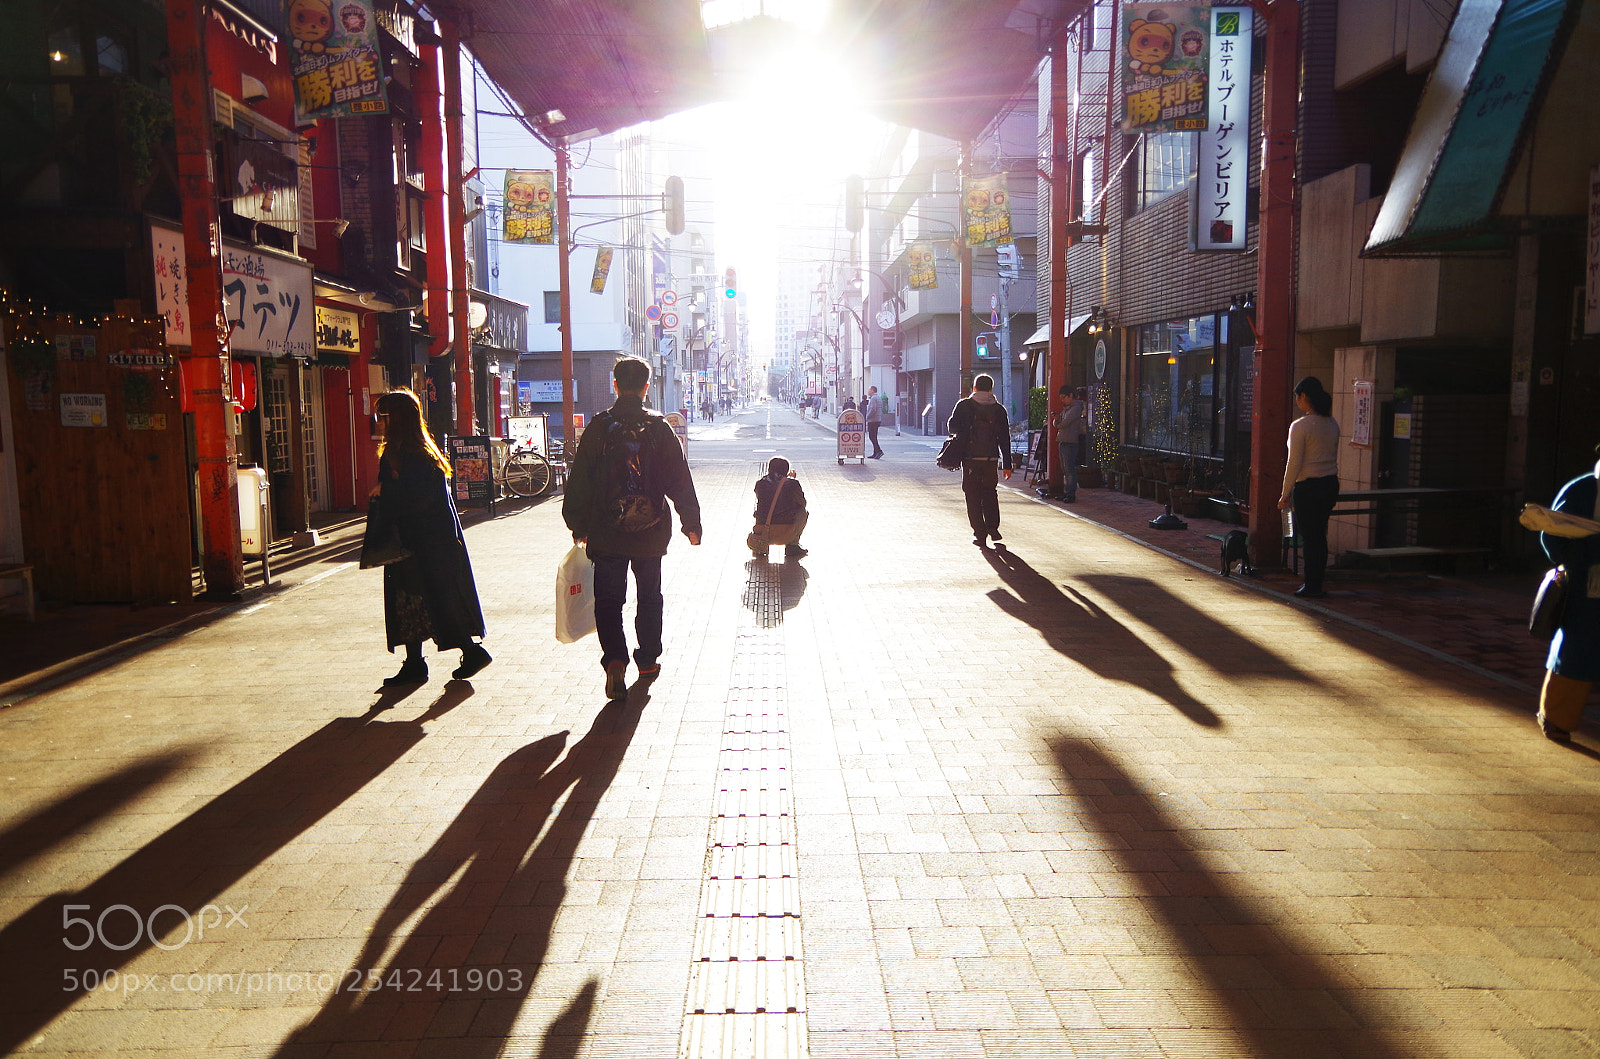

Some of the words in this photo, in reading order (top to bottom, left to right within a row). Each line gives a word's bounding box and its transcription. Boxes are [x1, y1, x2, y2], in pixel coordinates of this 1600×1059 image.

[298, 60, 377, 112] 勝利を
[1127, 81, 1204, 127] 勝利を
[1214, 40, 1235, 218] ホテルブーゲンビリア
[223, 252, 266, 282] モン酒場
[223, 278, 301, 342] コテツ
[108, 354, 175, 365] KITCHEN
